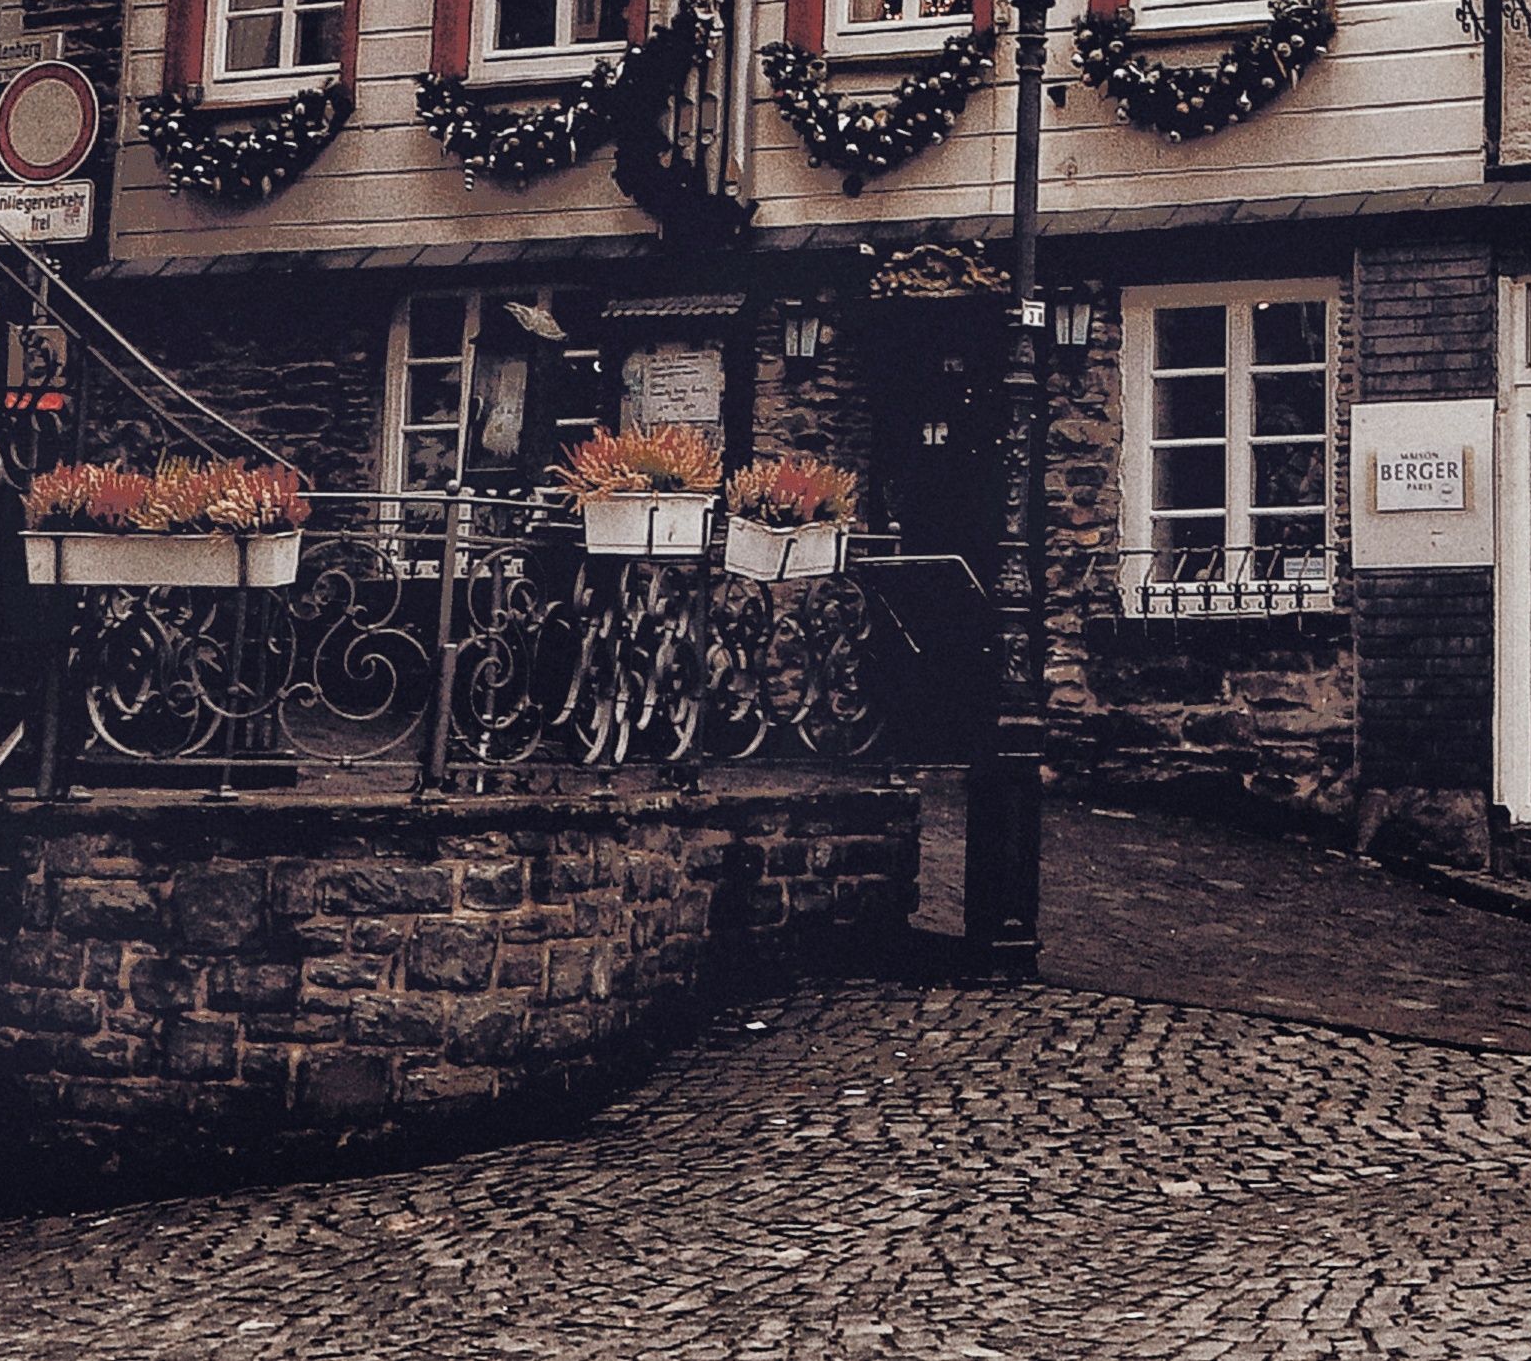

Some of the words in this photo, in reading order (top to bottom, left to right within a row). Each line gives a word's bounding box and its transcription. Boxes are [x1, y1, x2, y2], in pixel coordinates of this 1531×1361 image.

[1400, 451, 1439, 460] MAISON
[1380, 461, 1459, 482] BERGER
[1406, 483, 1433, 491] PARIS
